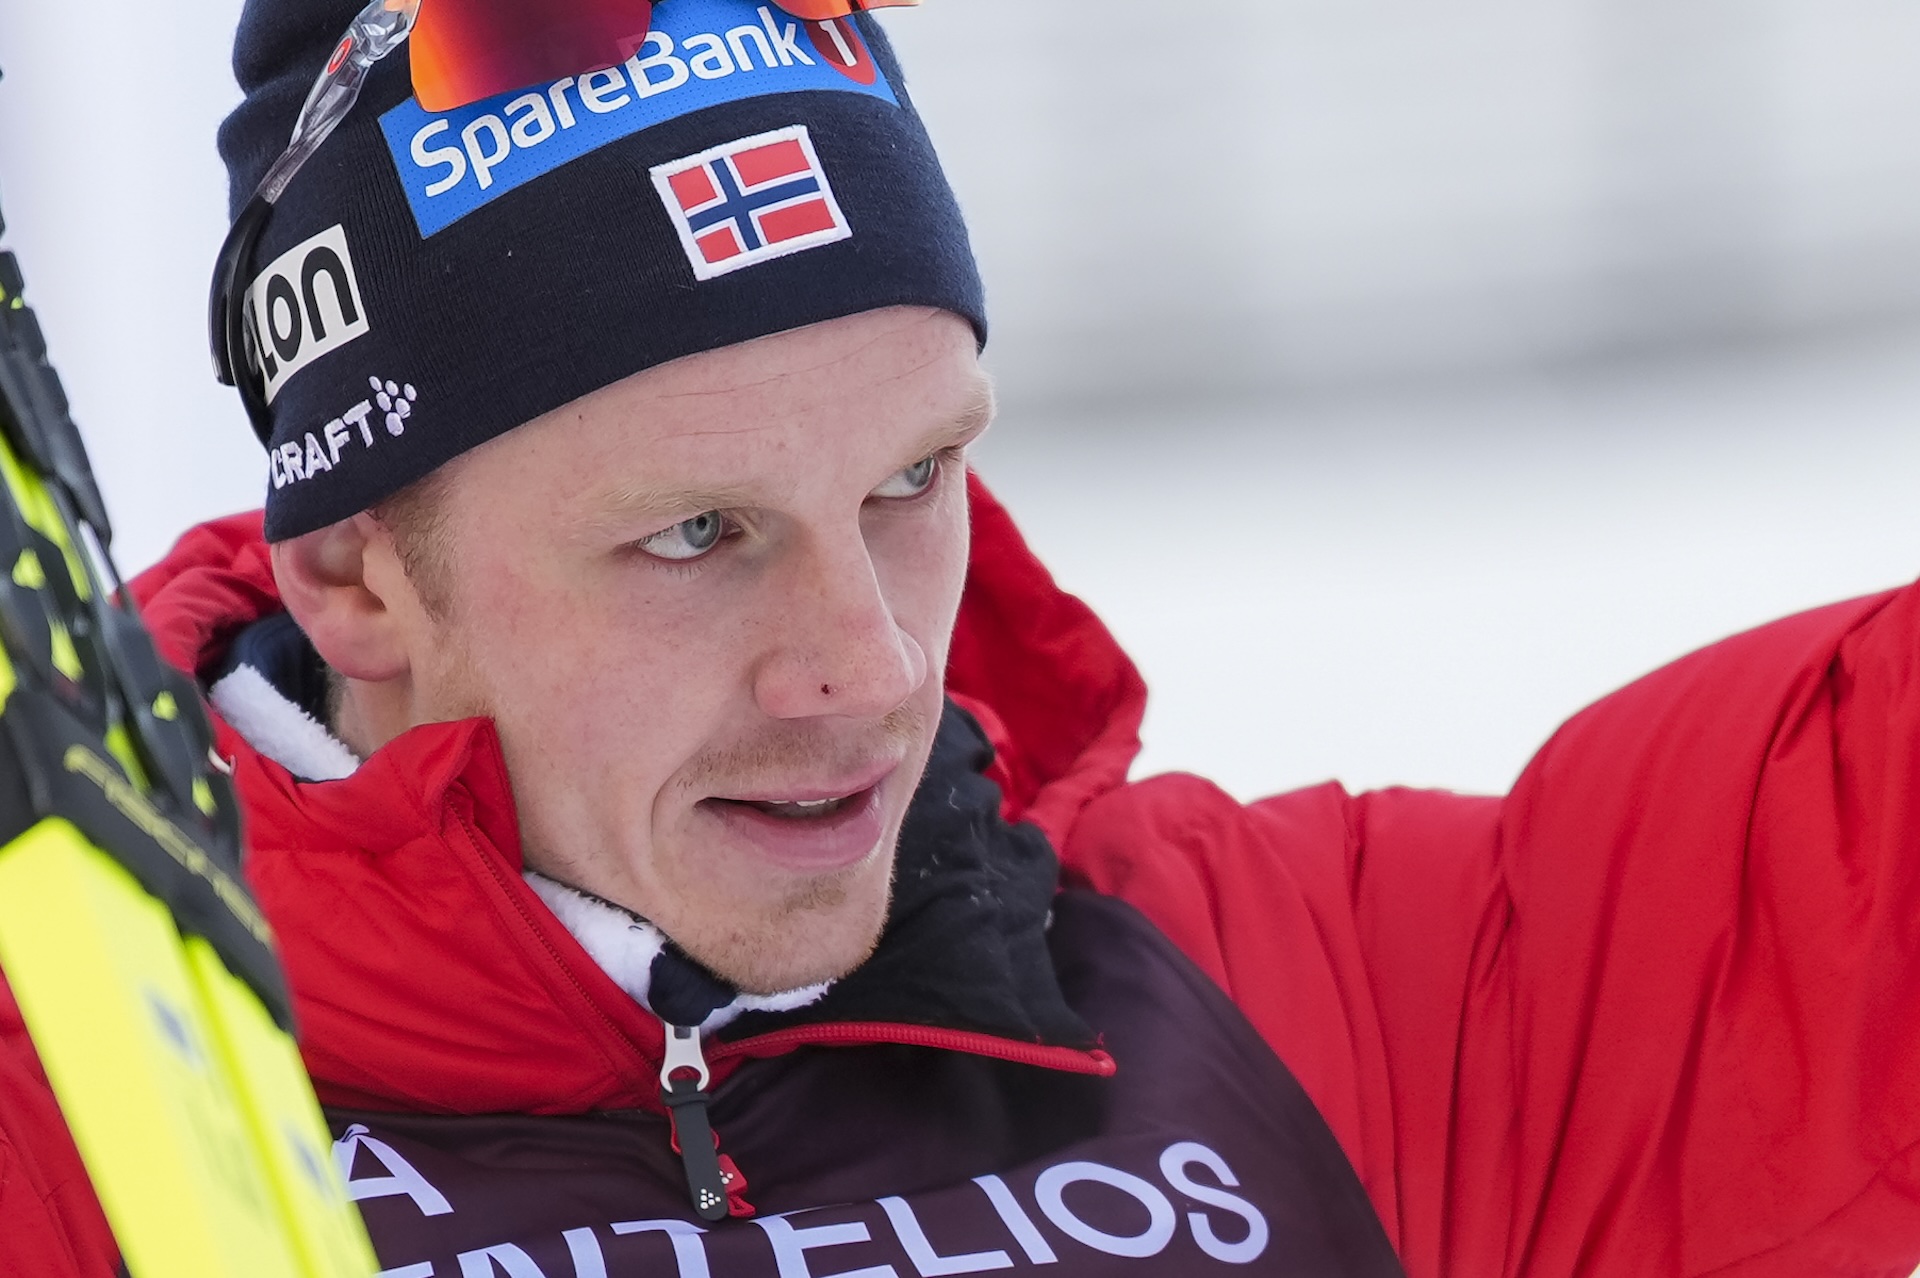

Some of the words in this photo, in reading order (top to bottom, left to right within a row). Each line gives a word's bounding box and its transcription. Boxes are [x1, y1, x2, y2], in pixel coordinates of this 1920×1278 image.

[410, 5, 817, 198] SpareBank
[818, 20, 858, 67] 1
[270, 399, 373, 490] CRAFT
[374, 1140, 1270, 1278] NTELIOS
